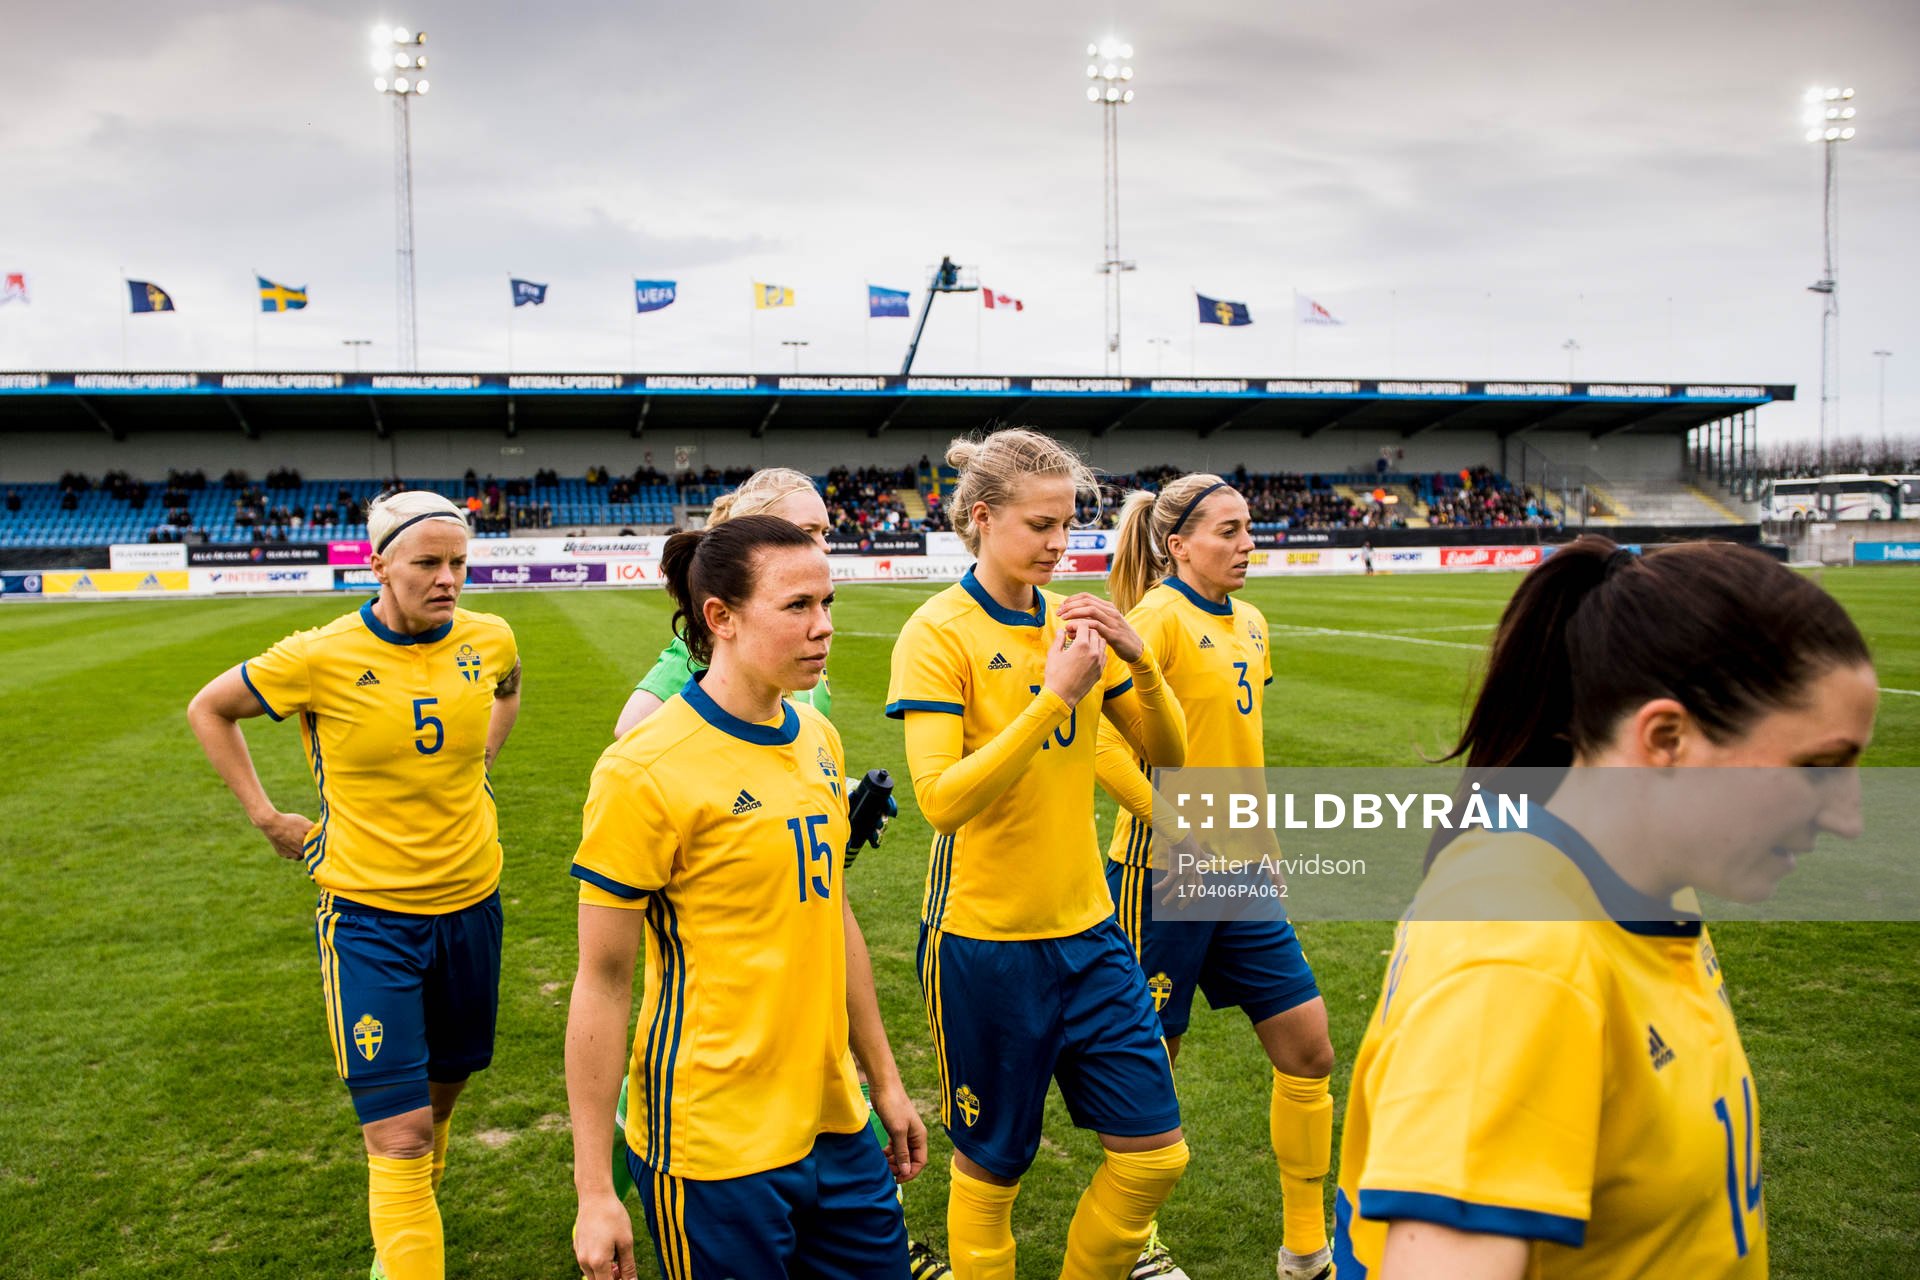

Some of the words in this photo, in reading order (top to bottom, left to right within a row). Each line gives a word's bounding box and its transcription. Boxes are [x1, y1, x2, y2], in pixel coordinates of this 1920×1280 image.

[638, 287, 674, 303] UEFA
[224, 571, 309, 583] INTERSPORT
[617, 565, 646, 580] ICA
[895, 566, 950, 575] SVENSKA
[987, 662, 1012, 671] adidas
[356, 679, 380, 687] adidas
[1232, 661, 1253, 715] 3
[412, 697, 445, 756] 5
[732, 799, 763, 816] adidas
[786, 813, 833, 903] 15
[1713, 1075, 1765, 1260] 14
